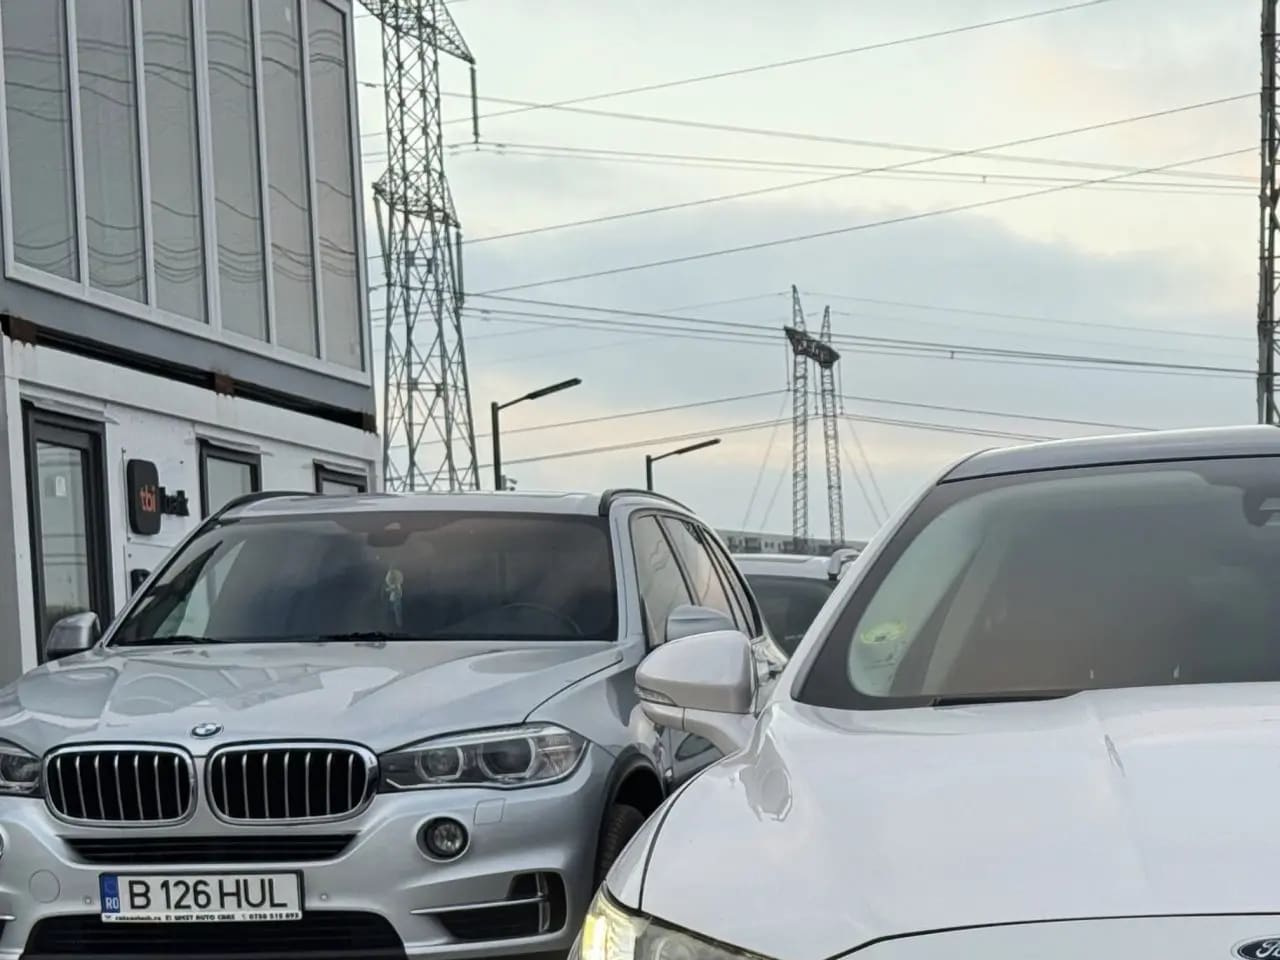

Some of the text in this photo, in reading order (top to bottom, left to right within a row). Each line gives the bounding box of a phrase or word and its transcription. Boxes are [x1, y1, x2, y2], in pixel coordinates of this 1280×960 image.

[140, 484, 156, 512] tbi
[105, 897, 119, 910] RO
[128, 878, 288, 909] B 126 HUL
